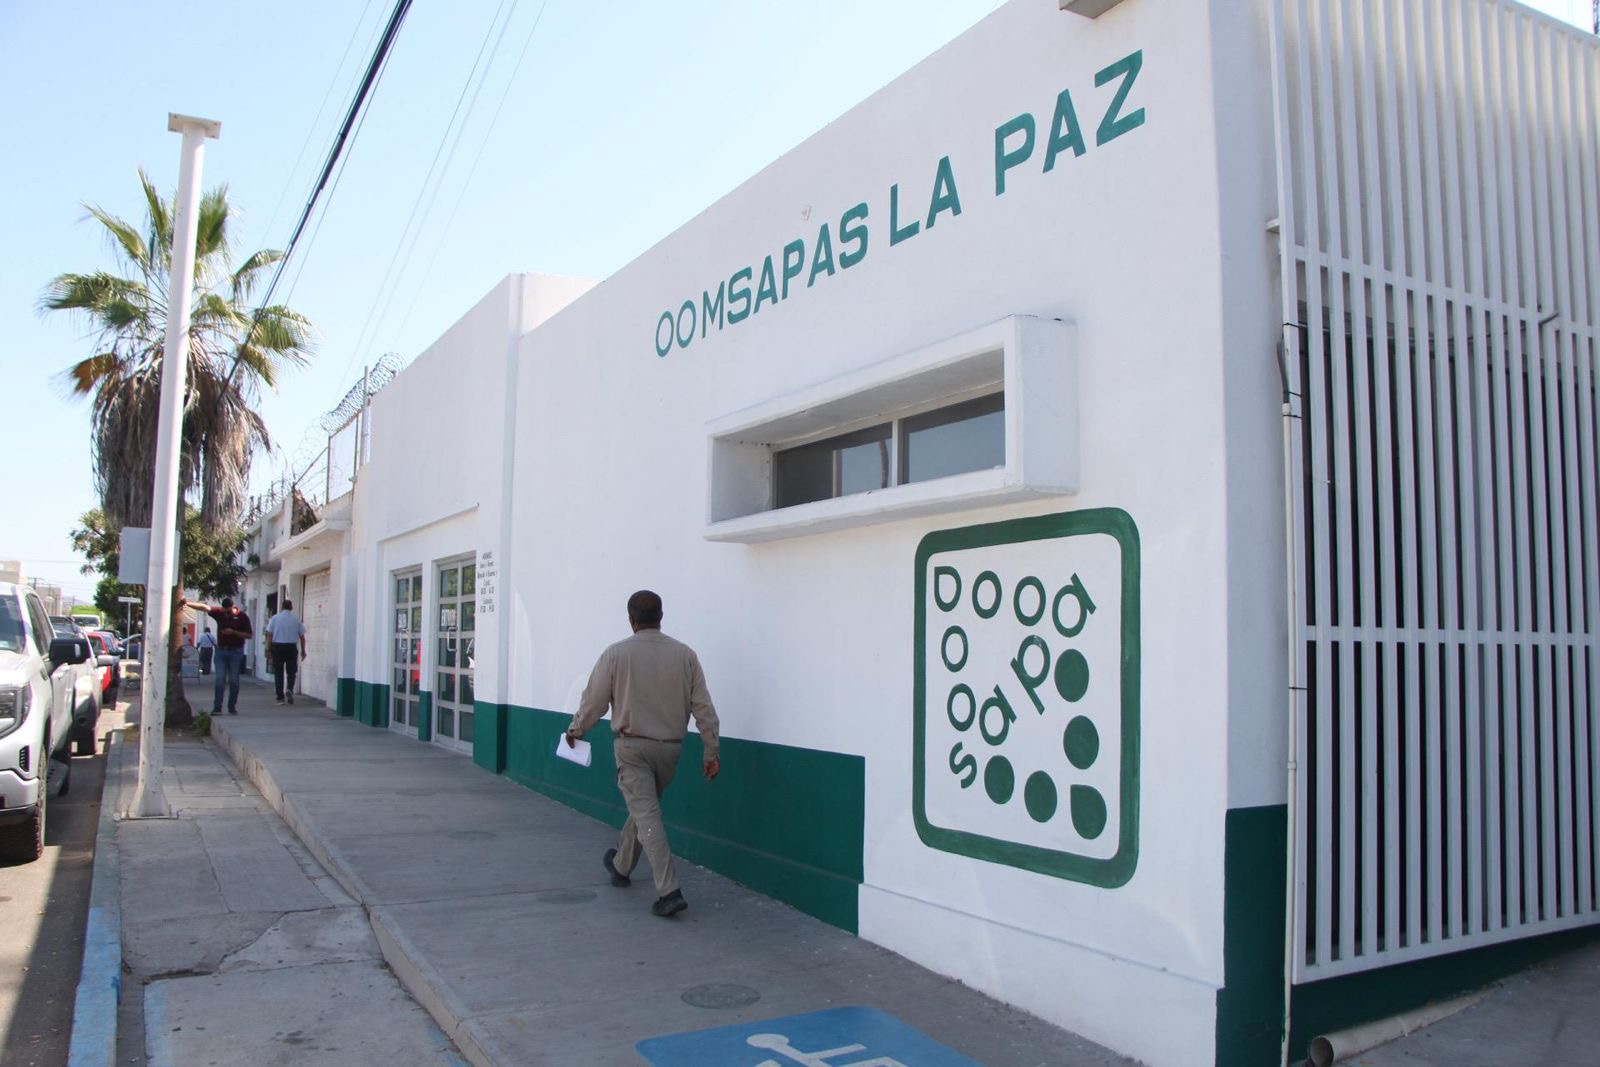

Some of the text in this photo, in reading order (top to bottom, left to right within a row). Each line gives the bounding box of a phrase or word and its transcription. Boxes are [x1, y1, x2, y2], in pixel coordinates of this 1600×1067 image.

[655, 49, 1146, 358] OOMSAPAS LA PAZ
